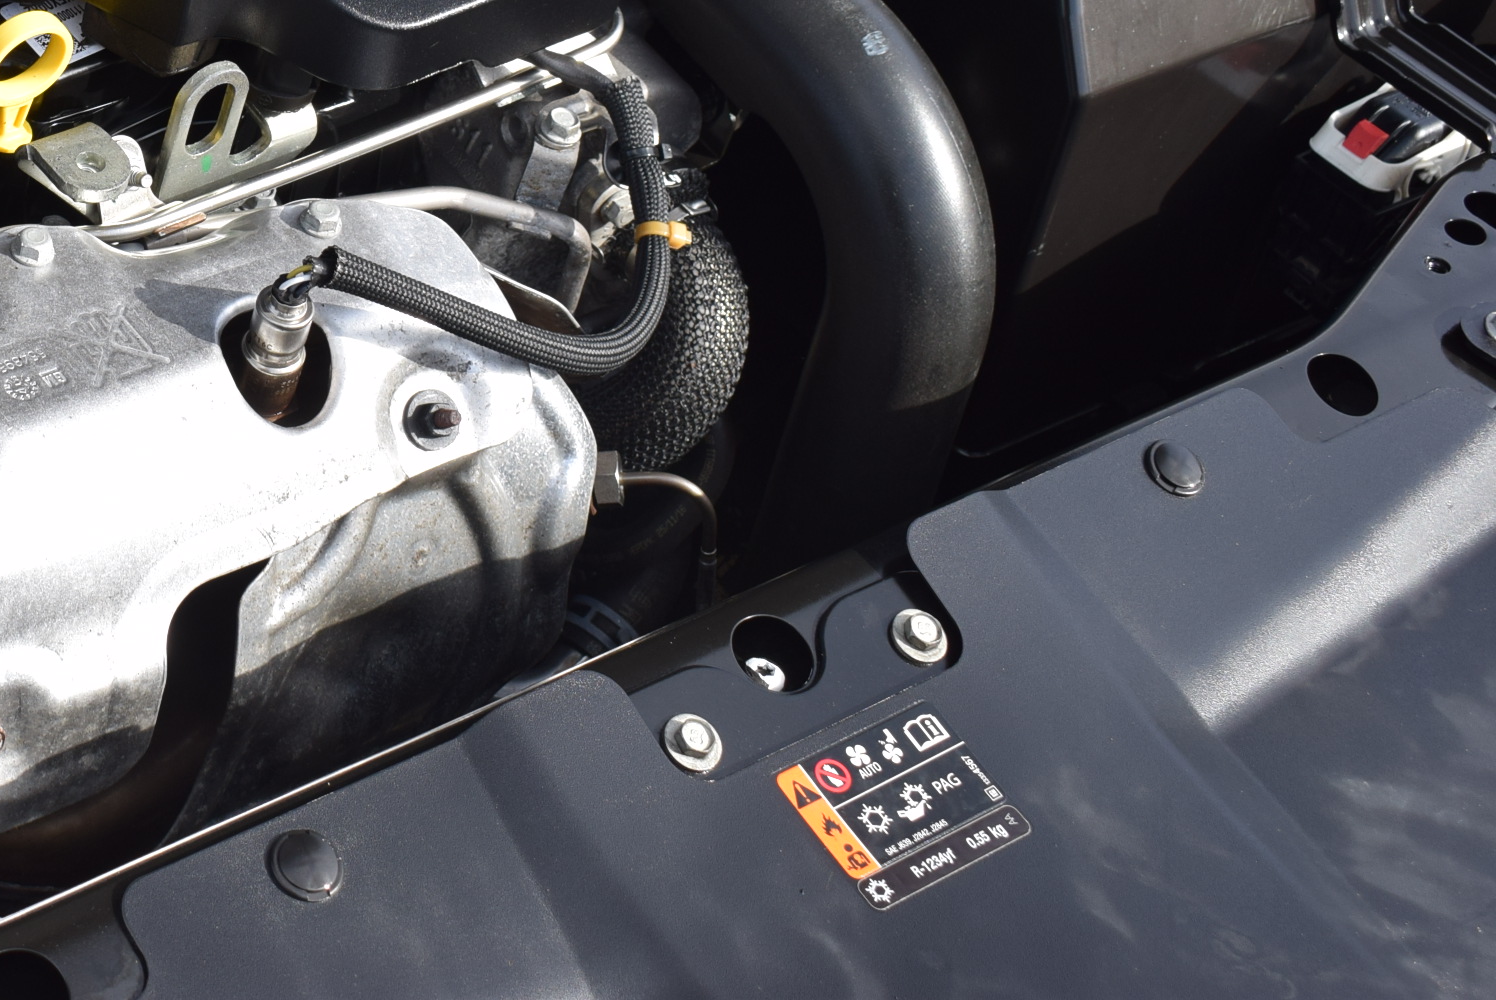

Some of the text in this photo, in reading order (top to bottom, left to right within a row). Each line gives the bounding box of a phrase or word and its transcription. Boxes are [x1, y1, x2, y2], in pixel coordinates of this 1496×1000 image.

[858, 761, 883, 780] AUTO
[931, 772, 962, 795] PAG
[884, 844, 899, 856] SAE
[909, 823, 1010, 879] R-1234yf 0.55 kg
